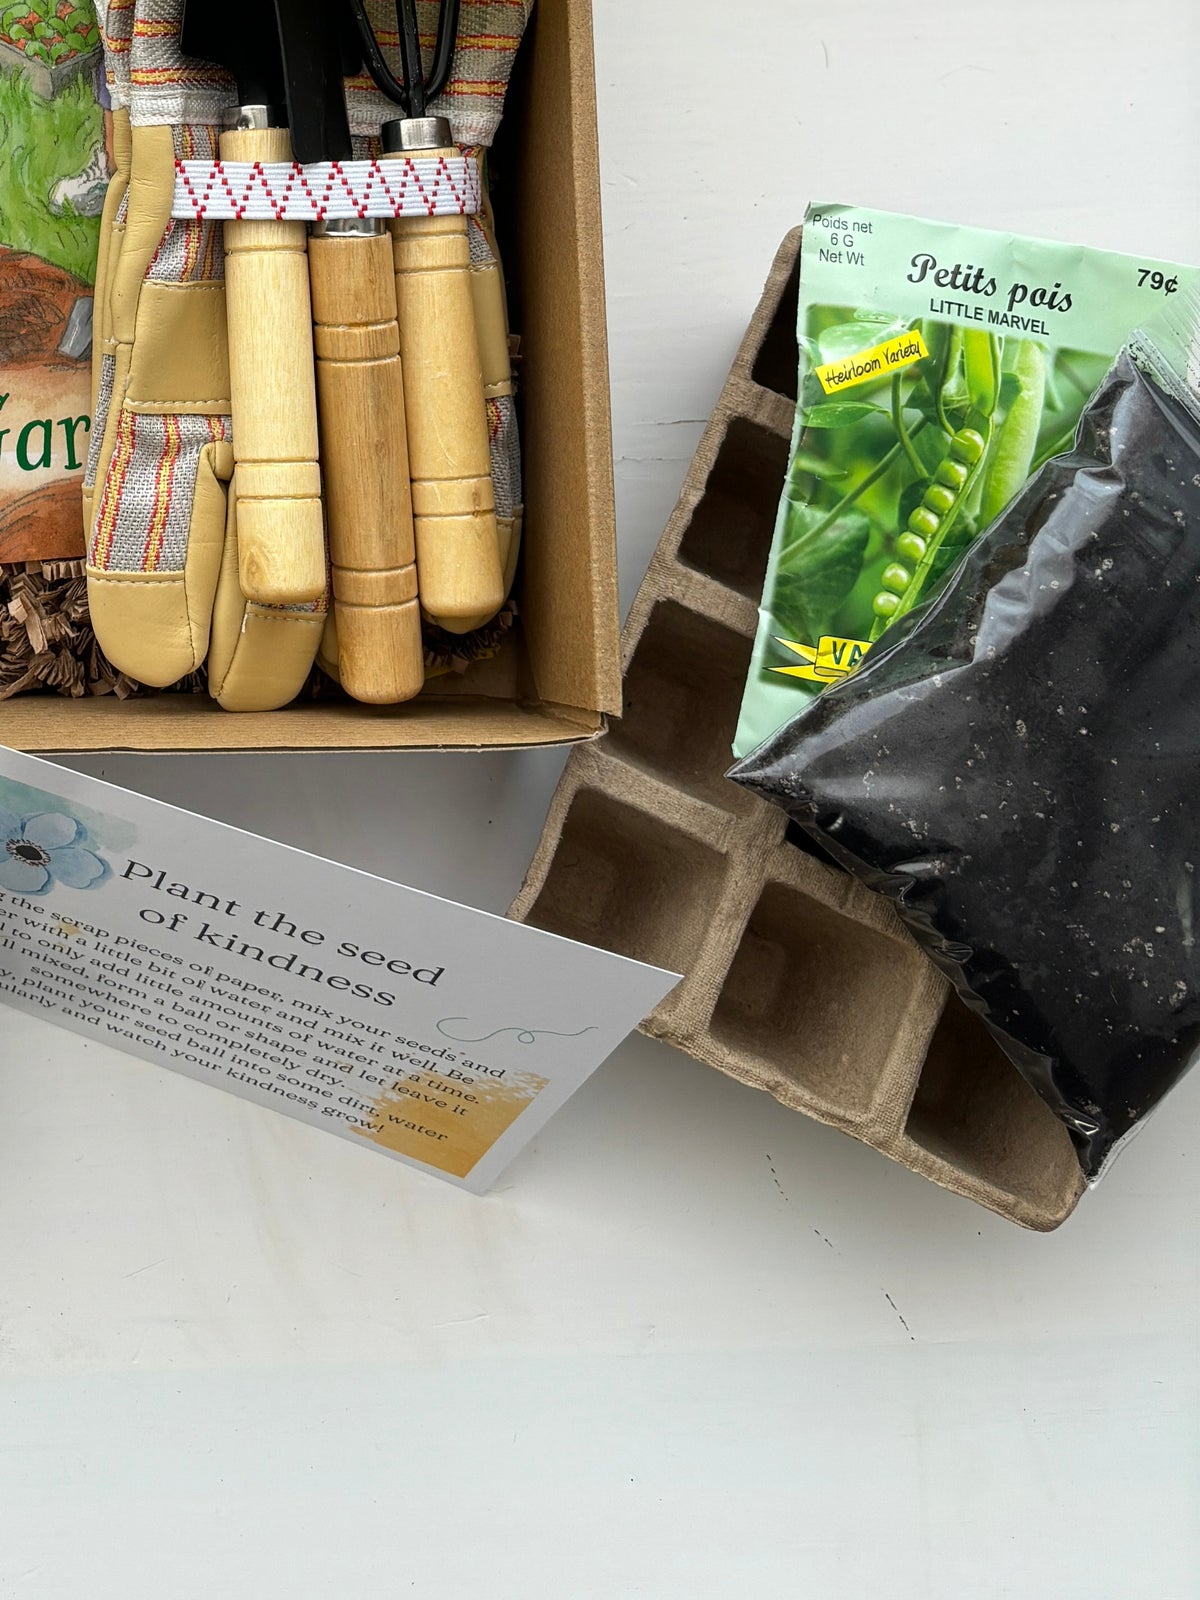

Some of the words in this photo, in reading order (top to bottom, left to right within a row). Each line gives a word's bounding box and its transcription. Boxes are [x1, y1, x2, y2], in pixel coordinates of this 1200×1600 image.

[812, 213, 849, 231] Poids
[852, 221, 873, 234] net
[818, 248, 843, 264] Net
[846, 251, 865, 266] Wt
[830, 232, 839, 246] 6
[842, 234, 854, 247] G
[906, 252, 998, 297] Petits
[1006, 282, 1074, 313] pois
[929, 298, 984, 321] LITTLE
[987, 310, 1050, 336] MARVEL
[1136, 268, 1179, 297] 79¢
[825, 360, 881, 389] Heirloom
[882, 339, 922, 366] Variety
[118, 858, 242, 917] Plant
[252, 909, 325, 945] the
[336, 941, 445, 987] seed
[138, 908, 188, 933] of
[192, 921, 396, 1006] kindness
[10, 896, 45, 914] the
[49, 911, 110, 938] scrap
[112, 934, 184, 965] pieces
[188, 962, 214, 977] of
[214, 971, 284, 1003] paper,
[290, 998, 334, 1019] mix
[334, 1014, 392, 1038] your
[393, 1035, 457, 1062] seeds
[460, 1058, 506, 1079] and
[11, 927, 32, 940] to
[37, 938, 85, 960] only
[88, 957, 130, 978] add
[134, 971, 184, 997] little
[187, 994, 284, 1033] amounts
[287, 1030, 314, 1043] of
[316, 1039, 379, 1066] water
[381, 1064, 405, 1077] at
[407, 1073, 421, 1083] a
[426, 1079, 479, 1104] time.
[20, 946, 89, 979] mixed,
[95, 972, 147, 1000] form
[152, 996, 165, 1006] a
[170, 1000, 211, 1023] ball
[215, 1019, 239, 1032] or
[243, 1030, 307, 1057] shape
[311, 1054, 354, 1074] and
[357, 1068, 386, 1086] let
[390, 1080, 448, 1108] leave
[451, 1103, 468, 1116] it
[22, 916, 69, 940] with
[74, 936, 87, 947] a
[92, 940, 142, 966] little
[146, 960, 177, 979] bit
[180, 976, 206, 990] of
[209, 984, 273, 1014] water
[274, 1009, 319, 1030] and
[321, 1026, 366, 1047] mix
[368, 1040, 386, 1053] it
[390, 1049, 438, 1073] well.
[443, 1067, 475, 1085] Be
[29, 965, 152, 1015] somewhere
[157, 1012, 178, 1025] to
[182, 1023, 302, 1071] completely
[304, 1068, 345, 1088] dry.
[20, 977, 75, 1002] plant
[77, 998, 130, 1021] your
[133, 1019, 182, 1042] seed
[186, 1036, 226, 1058] ball
[229, 1053, 271, 1075] into
[275, 1072, 333, 1098] some
[337, 1095, 380, 1117] dirt,
[387, 1113, 448, 1141] water
[60, 1006, 101, 1026] and
[105, 1022, 167, 1051] watch
[169, 1048, 222, 1071] your
[225, 1066, 319, 1110] kindness
[320, 1105, 385, 1133] grow!
